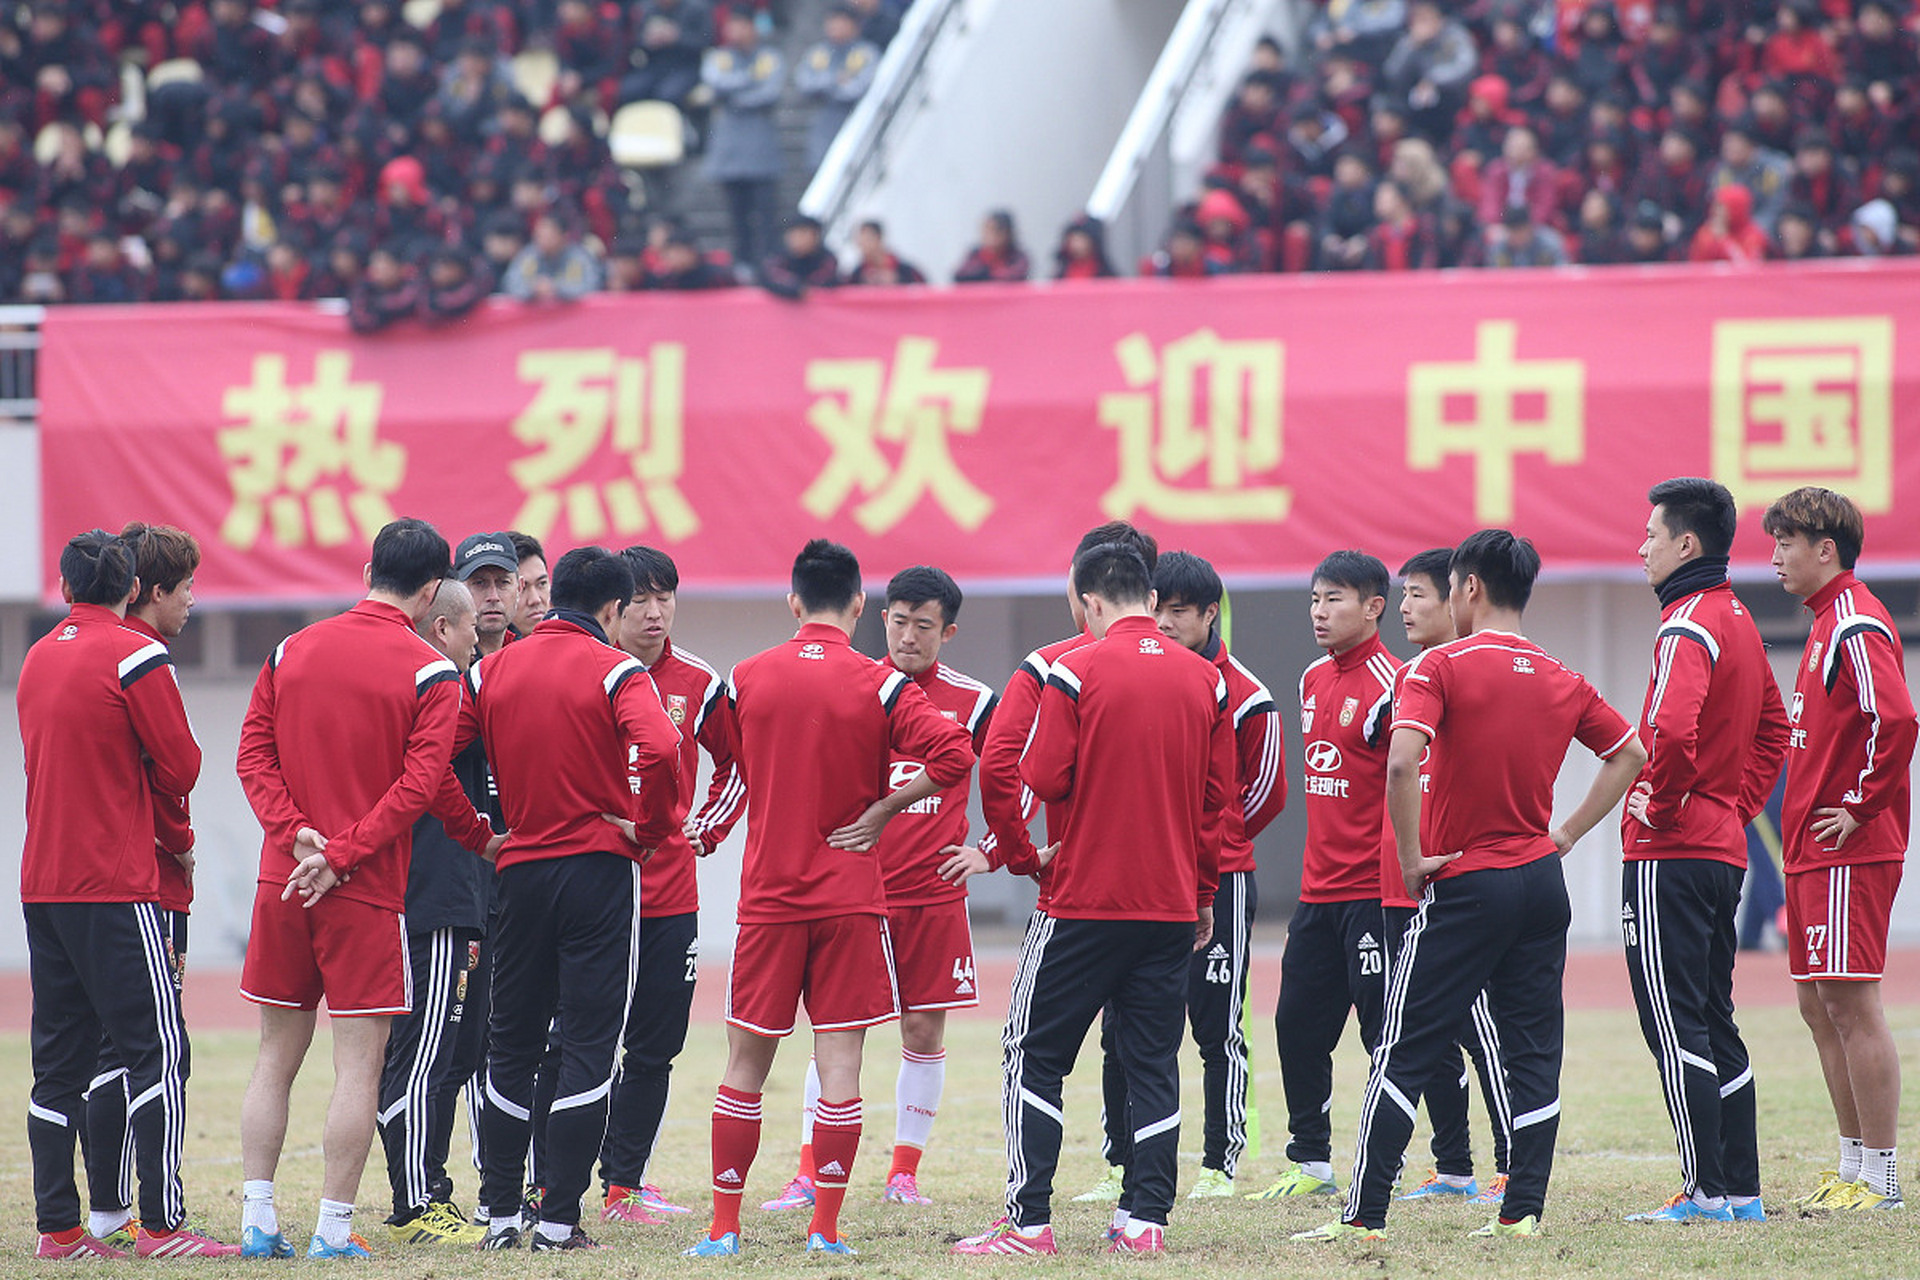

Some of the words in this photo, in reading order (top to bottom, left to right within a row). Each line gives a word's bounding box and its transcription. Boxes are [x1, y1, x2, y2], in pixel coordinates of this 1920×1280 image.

[217, 317, 1894, 550] 热烈欢迎中国
[464, 542, 504, 559] adidas
[1806, 924, 1827, 951] 27
[952, 956, 974, 982] 44
[1206, 959, 1231, 984] 46
[1359, 950, 1382, 975] 20
